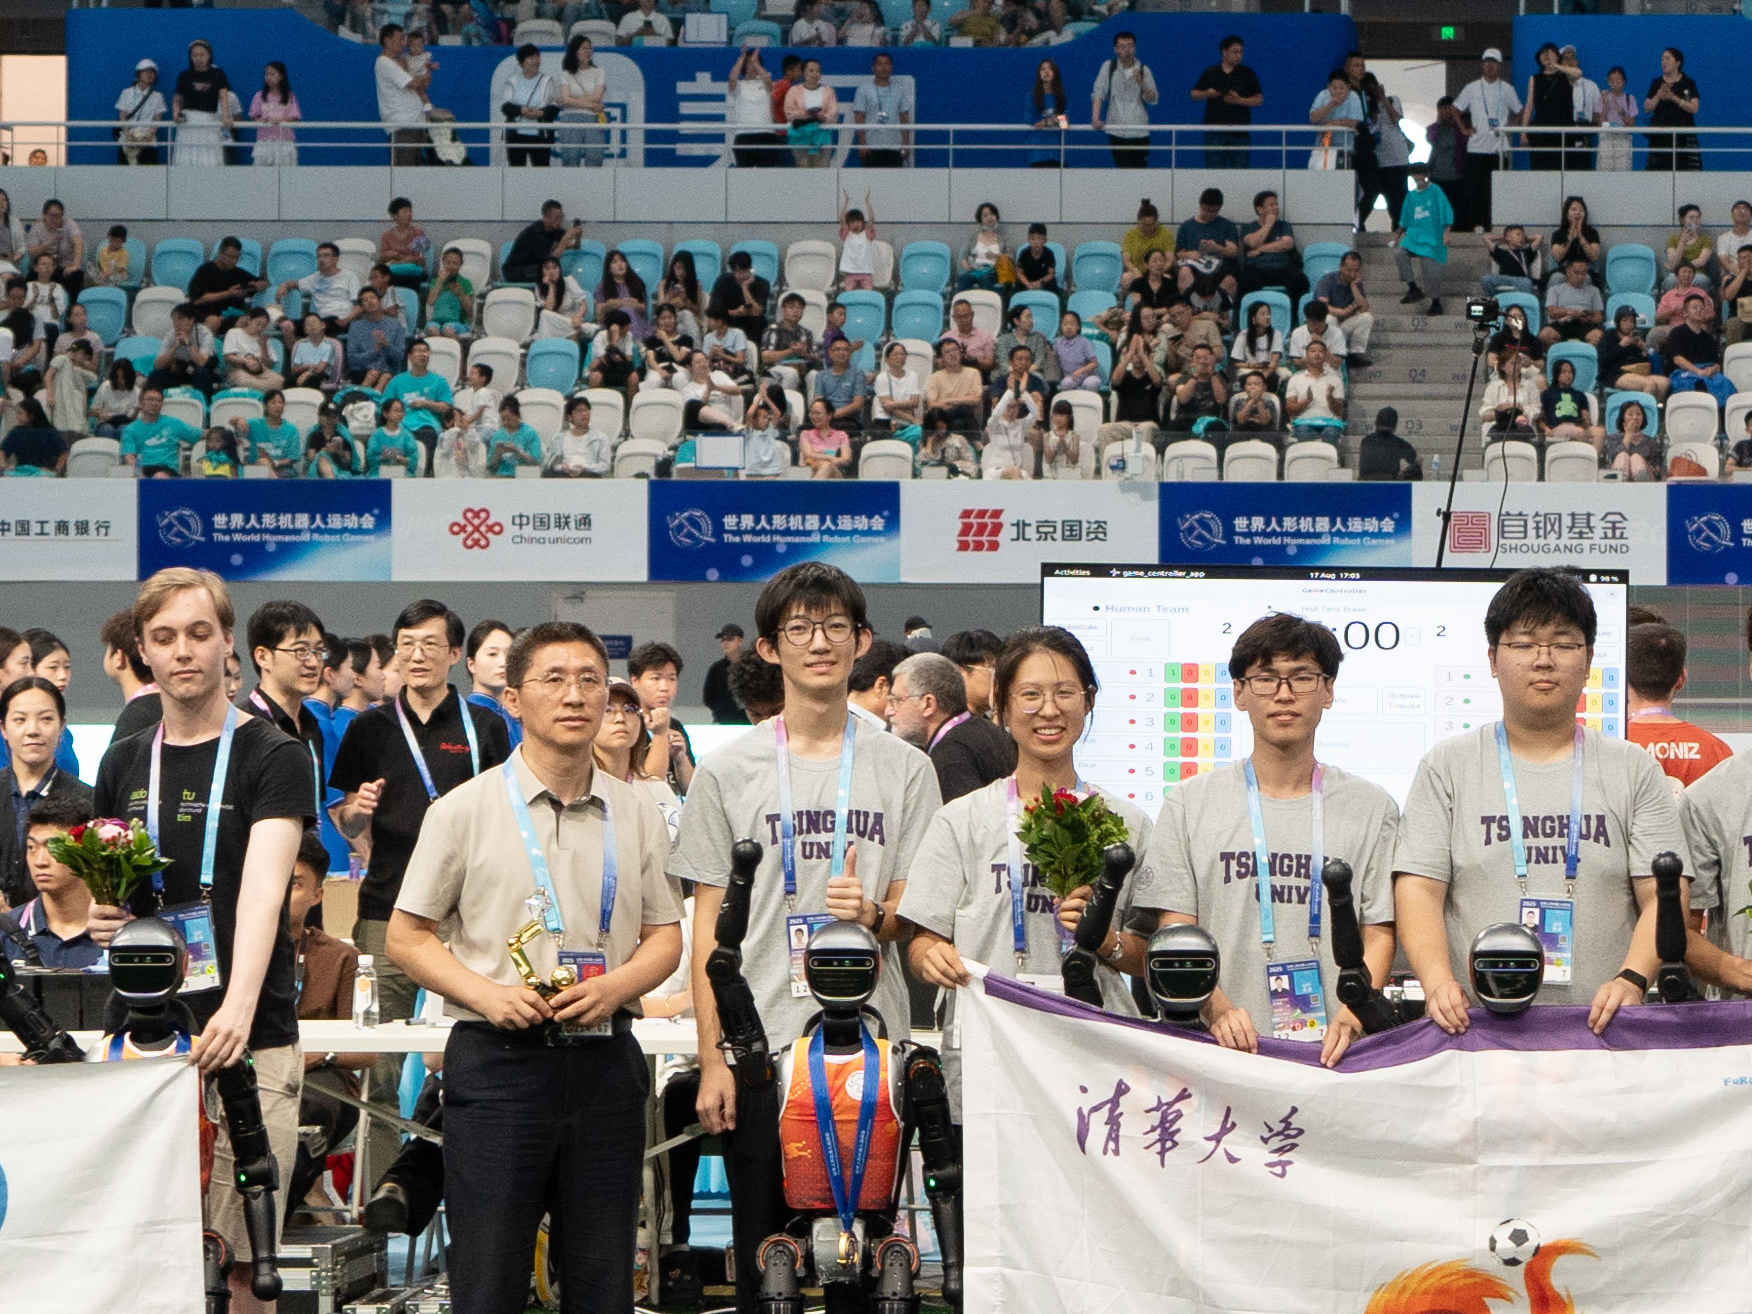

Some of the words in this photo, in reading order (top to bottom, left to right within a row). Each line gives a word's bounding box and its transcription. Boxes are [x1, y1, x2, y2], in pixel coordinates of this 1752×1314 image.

[212, 513, 375, 530] 世界人形机器人运动会
[511, 513, 593, 532] 中国联通
[723, 514, 885, 531] 世界人形机器人运动会
[1233, 517, 1396, 534] 世界人形机器人运动会
[1498, 510, 1630, 540] 首钢基金
[1010, 519, 1109, 543] 北京国资
[511, 534, 545, 546] China
[548, 535, 592, 546] unicom
[1499, 543, 1584, 555] SHOUGANG
[1588, 543, 1630, 555] FUND
[1054, 568, 1091, 577] Activities
[1339, 571, 1361, 580] 17:03
[1104, 603, 1151, 614] Human
[1155, 603, 1190, 614] Team
[1221, 622, 1232, 634] 2
[1435, 624, 1447, 636] 2
